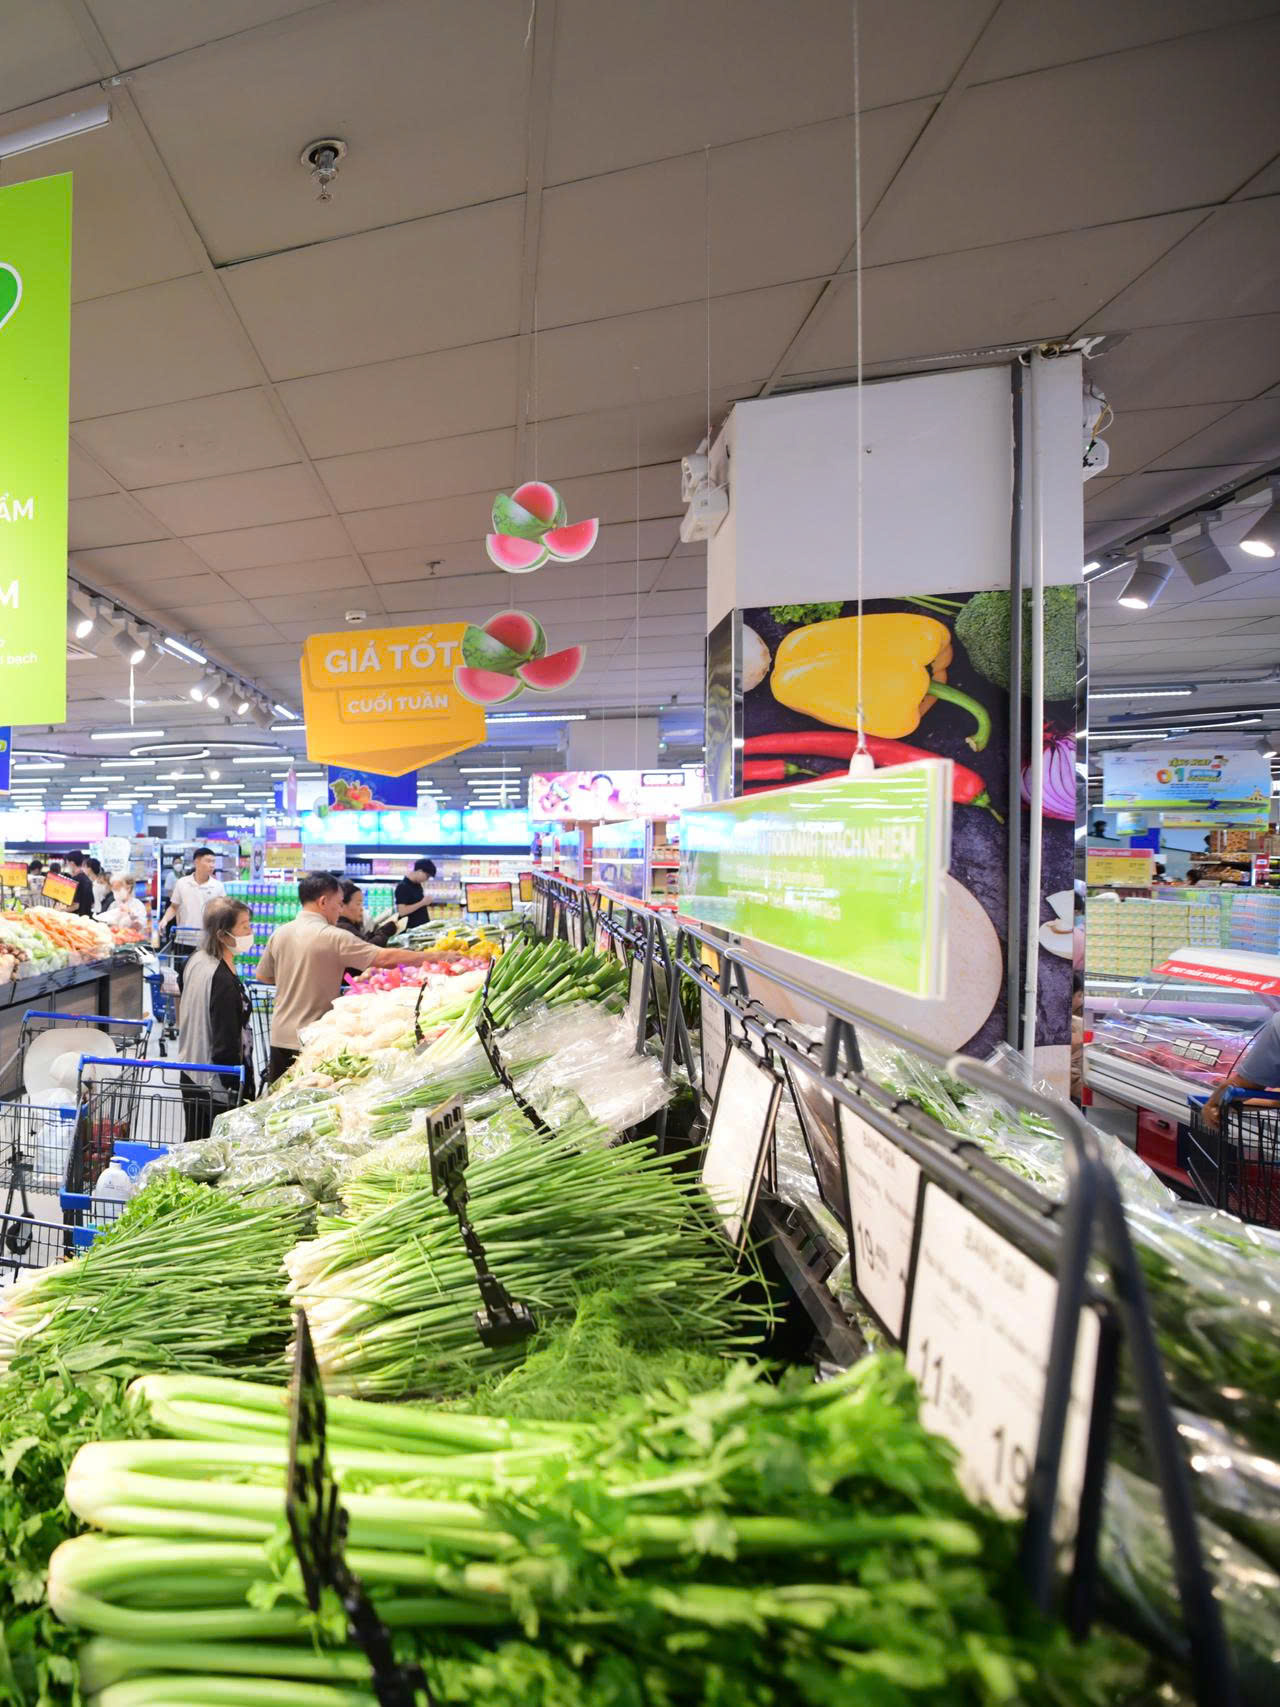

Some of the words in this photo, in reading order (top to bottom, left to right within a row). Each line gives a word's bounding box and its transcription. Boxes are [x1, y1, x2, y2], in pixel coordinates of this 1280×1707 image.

[325, 640, 381, 672] GIÁ
[387, 633, 460, 670] TỐT
[347, 692, 393, 713] CUỐI
[397, 689, 449, 709] TUẦN
